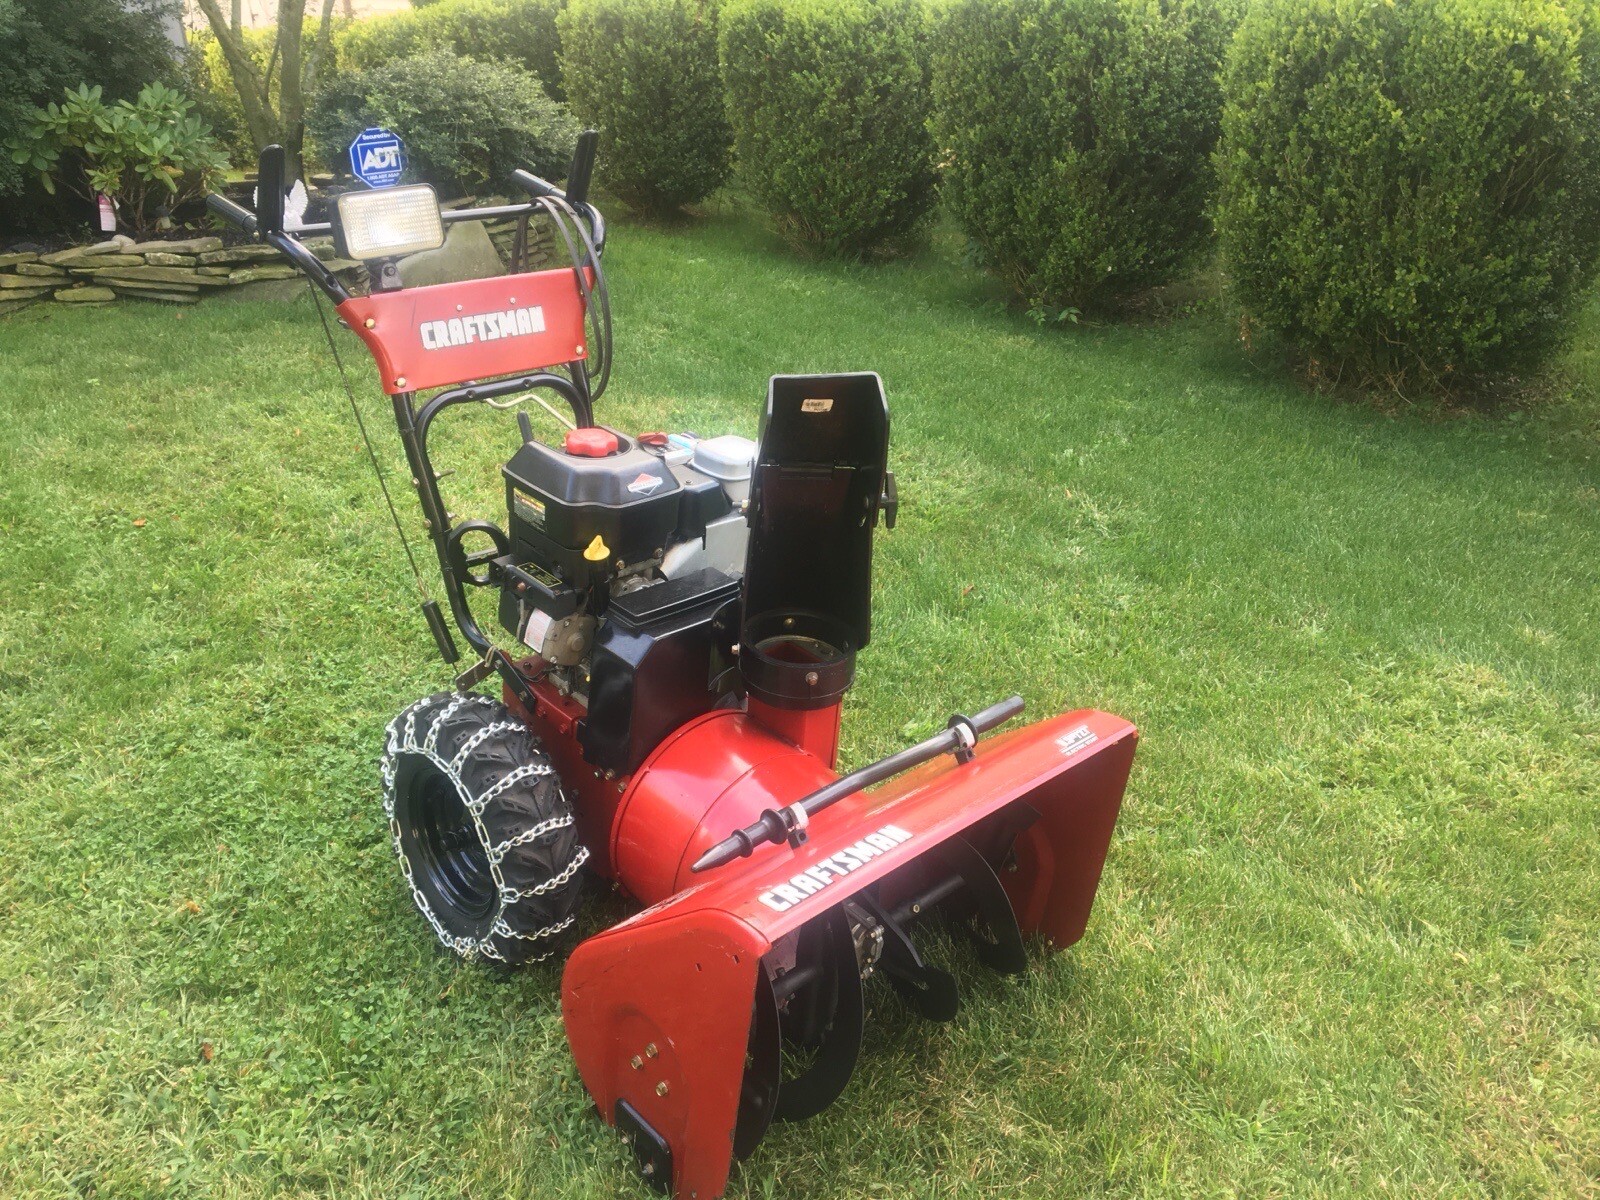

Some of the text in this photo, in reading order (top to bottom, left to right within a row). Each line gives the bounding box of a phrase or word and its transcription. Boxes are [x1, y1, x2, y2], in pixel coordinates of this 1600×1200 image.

[363, 146, 399, 170] ADT
[420, 305, 546, 350] CRAFTSMAN
[757, 824, 914, 912] CRAFTSMAN
